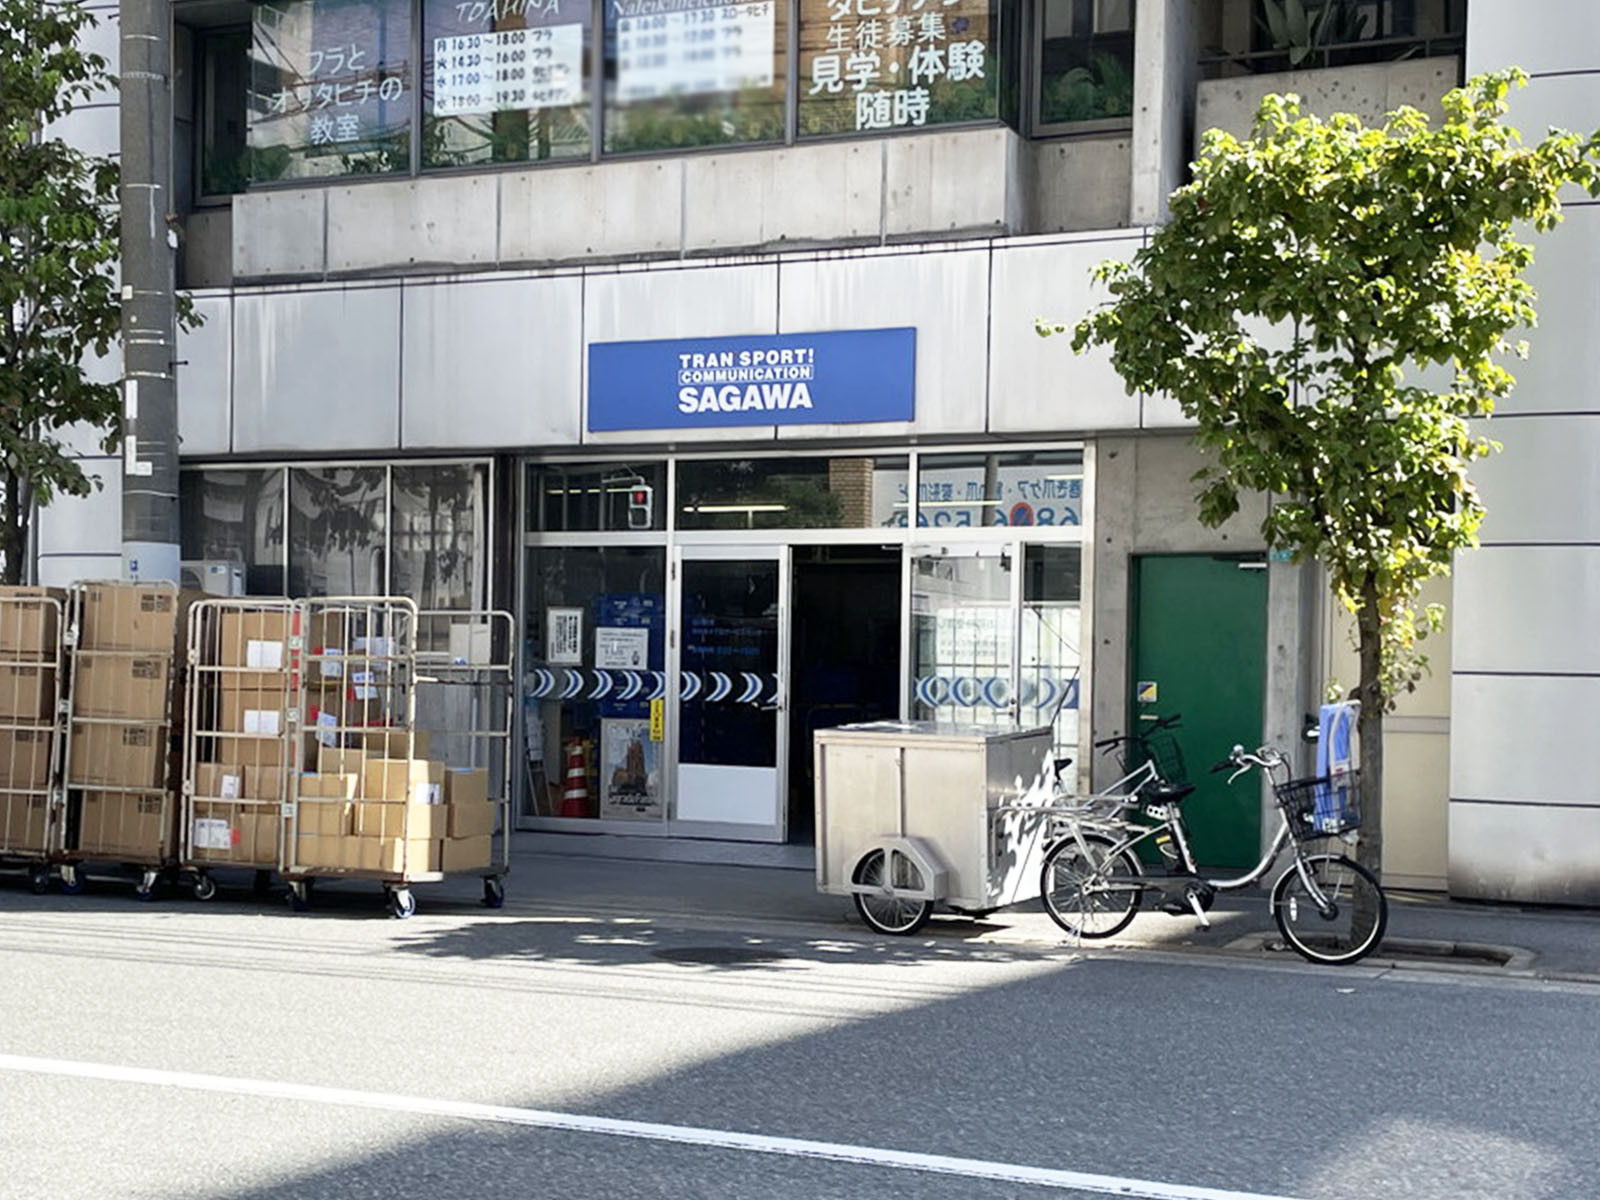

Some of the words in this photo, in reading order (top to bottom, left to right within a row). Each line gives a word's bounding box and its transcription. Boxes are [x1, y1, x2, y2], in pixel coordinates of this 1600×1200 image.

[825, 11, 946, 53] 生徒募集
[308, 43, 366, 74] フラと
[809, 39, 986, 95] 見学・体験
[856, 86, 930, 131] 随時
[311, 114, 360, 144] 教室
[681, 366, 810, 383] COMMUNICATION
[678, 383, 813, 414] SAGAWA
